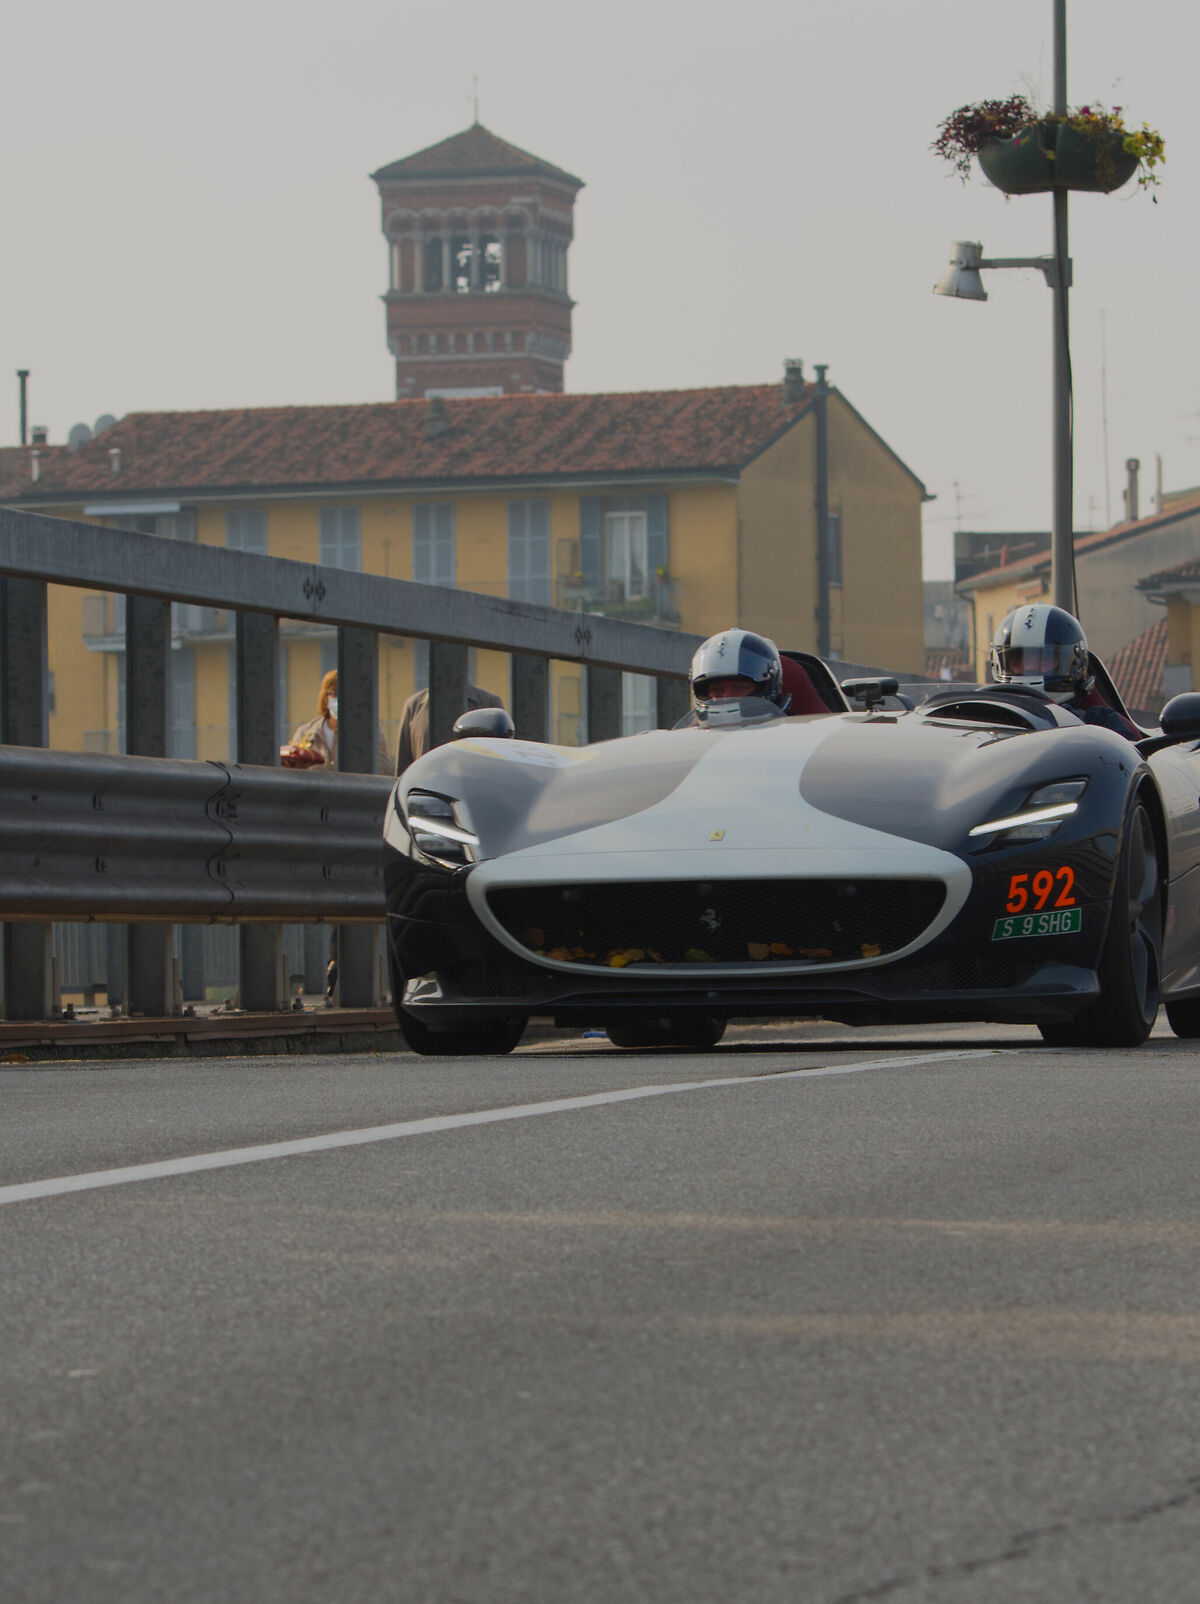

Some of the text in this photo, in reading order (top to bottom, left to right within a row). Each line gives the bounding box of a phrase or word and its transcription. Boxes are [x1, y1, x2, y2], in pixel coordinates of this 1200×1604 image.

[1006, 865, 1076, 913] 592
[1002, 912, 1072, 937] S 9 SHG
